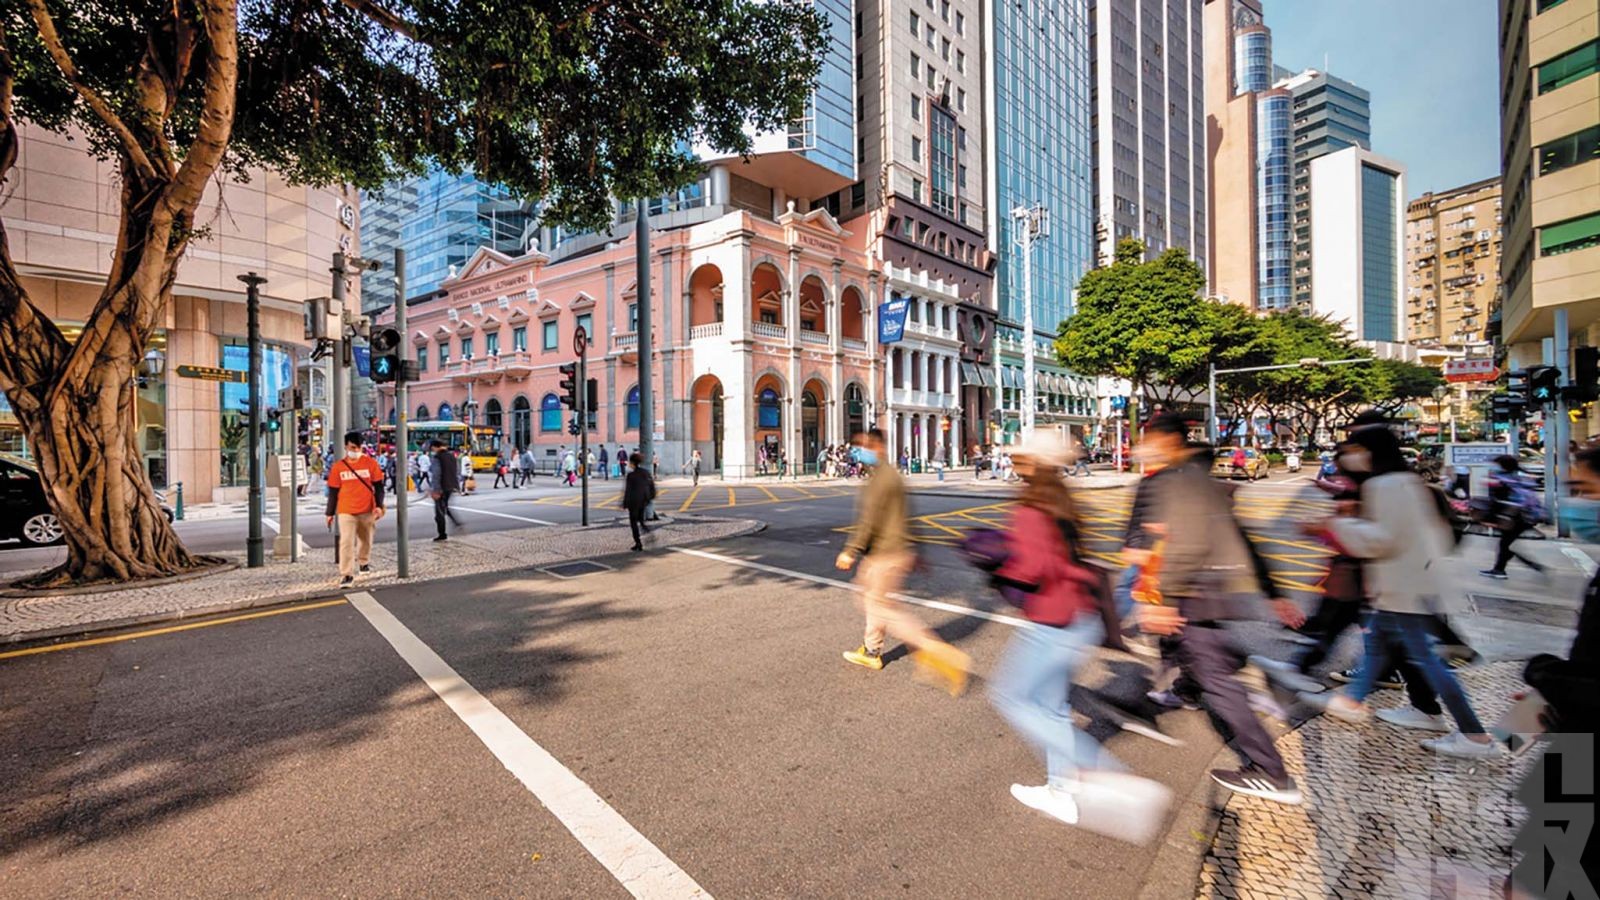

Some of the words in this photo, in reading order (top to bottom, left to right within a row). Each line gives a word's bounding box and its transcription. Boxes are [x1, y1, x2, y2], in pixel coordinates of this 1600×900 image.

[453, 291, 469, 301] BANCO
[470, 285, 492, 296] NACIONAL
[495, 274, 527, 289] ULTRAMARINO
